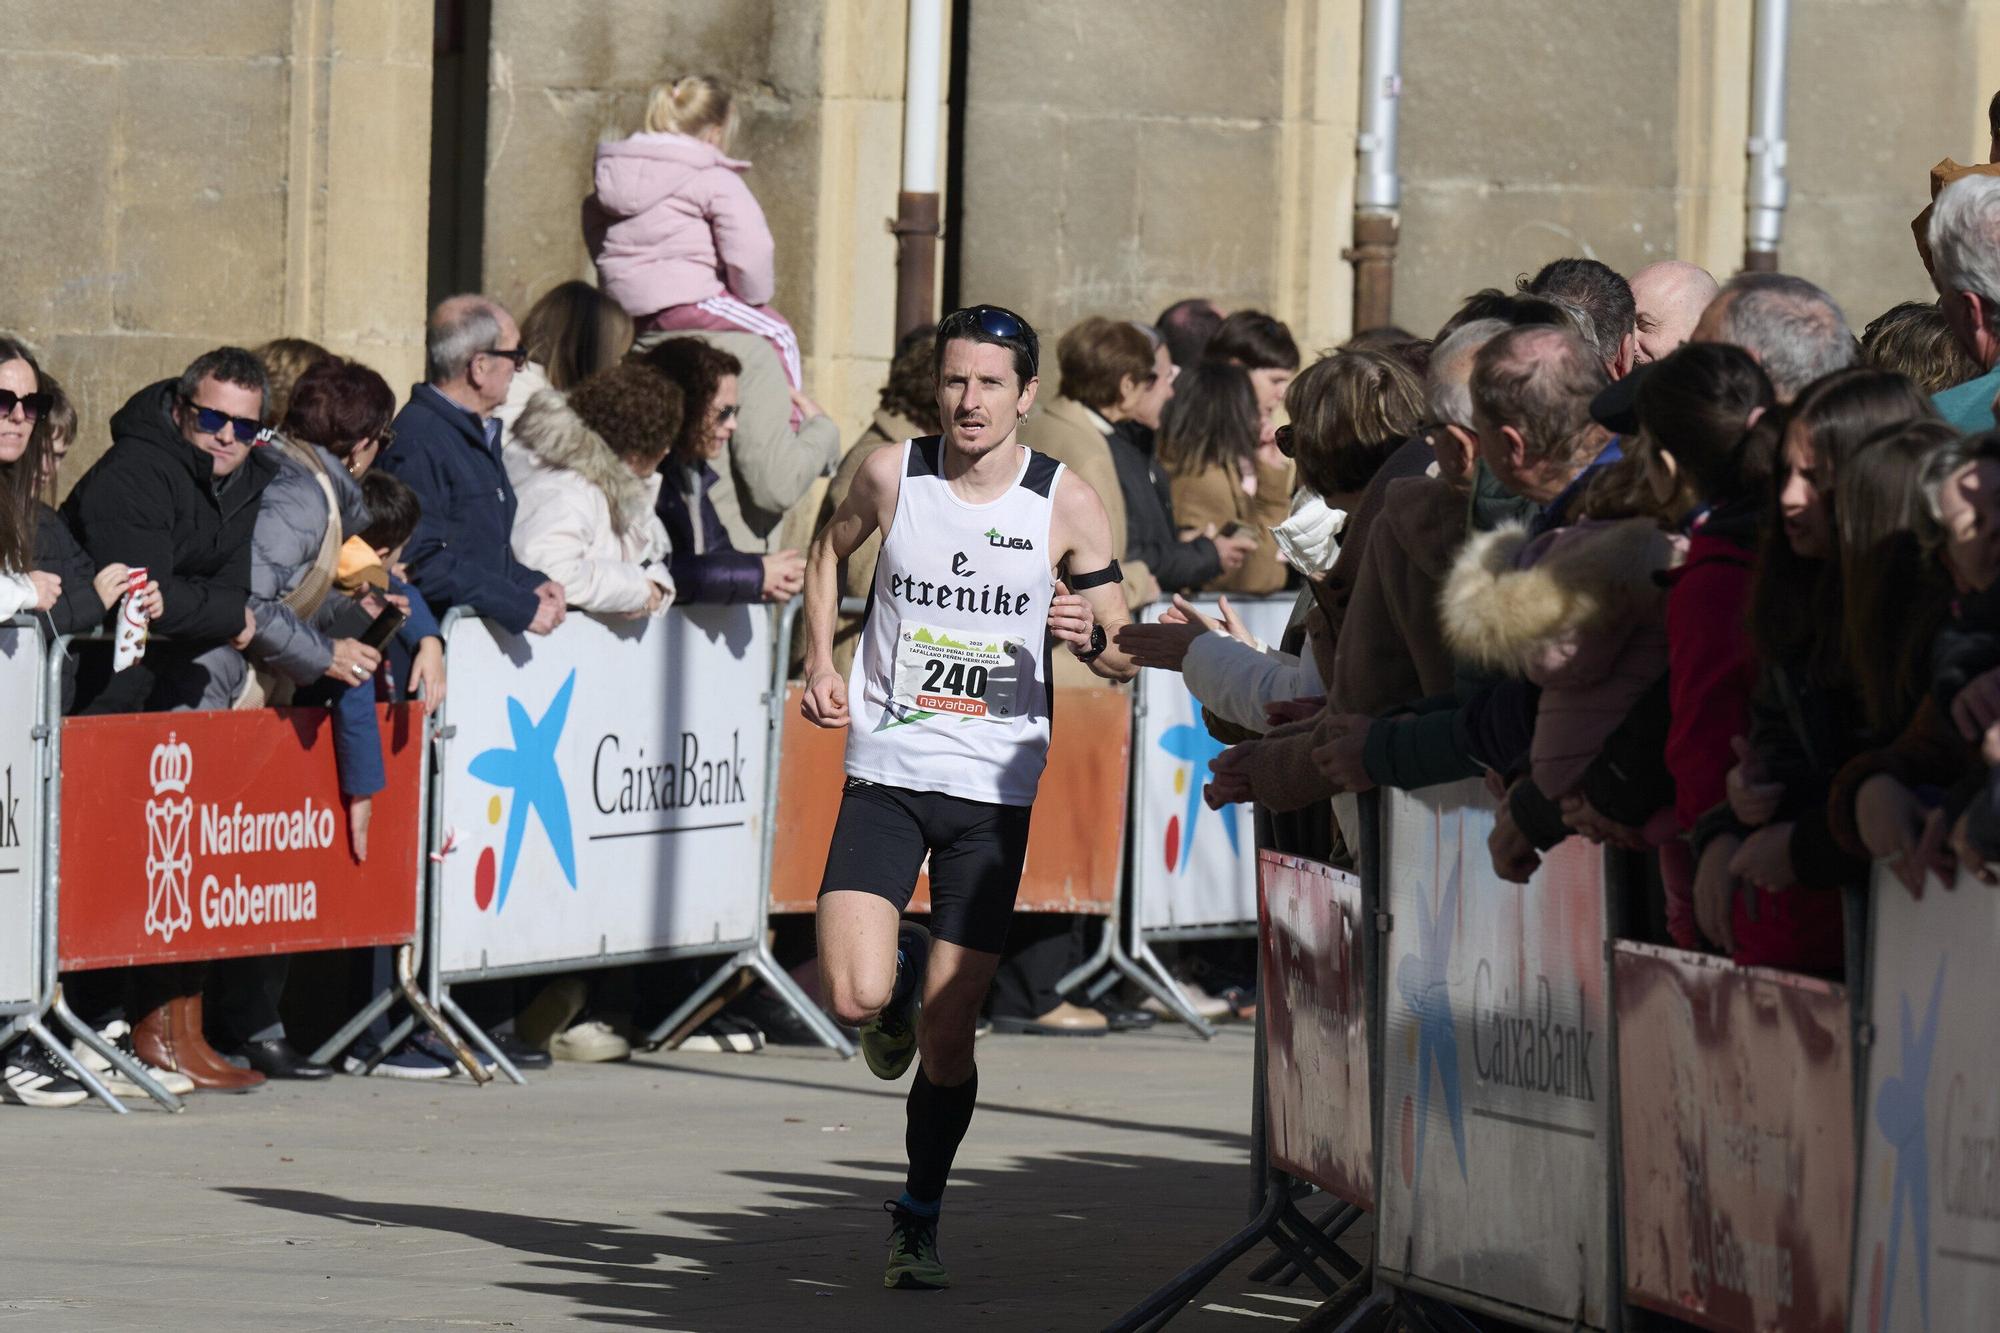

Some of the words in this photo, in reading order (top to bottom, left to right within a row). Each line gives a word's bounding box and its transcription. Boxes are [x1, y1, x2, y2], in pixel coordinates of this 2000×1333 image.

[989, 534, 1034, 551] LUGA
[891, 573, 1031, 616] etxenike
[909, 648, 942, 658] TAFALLAKO
[943, 653, 962, 661] PEÑEN
[963, 656, 980, 664] HERRI
[946, 647, 965, 656] PEÑAS
[976, 652, 1000, 660] TAFALLA
[921, 659, 988, 699] 240
[919, 697, 983, 714] navarban
[592, 727, 746, 815] CaixaBank
[200, 797, 335, 856] Nafarroako
[200, 873, 317, 929] Gobernua
[1473, 957, 1595, 1102] CaixaBank
